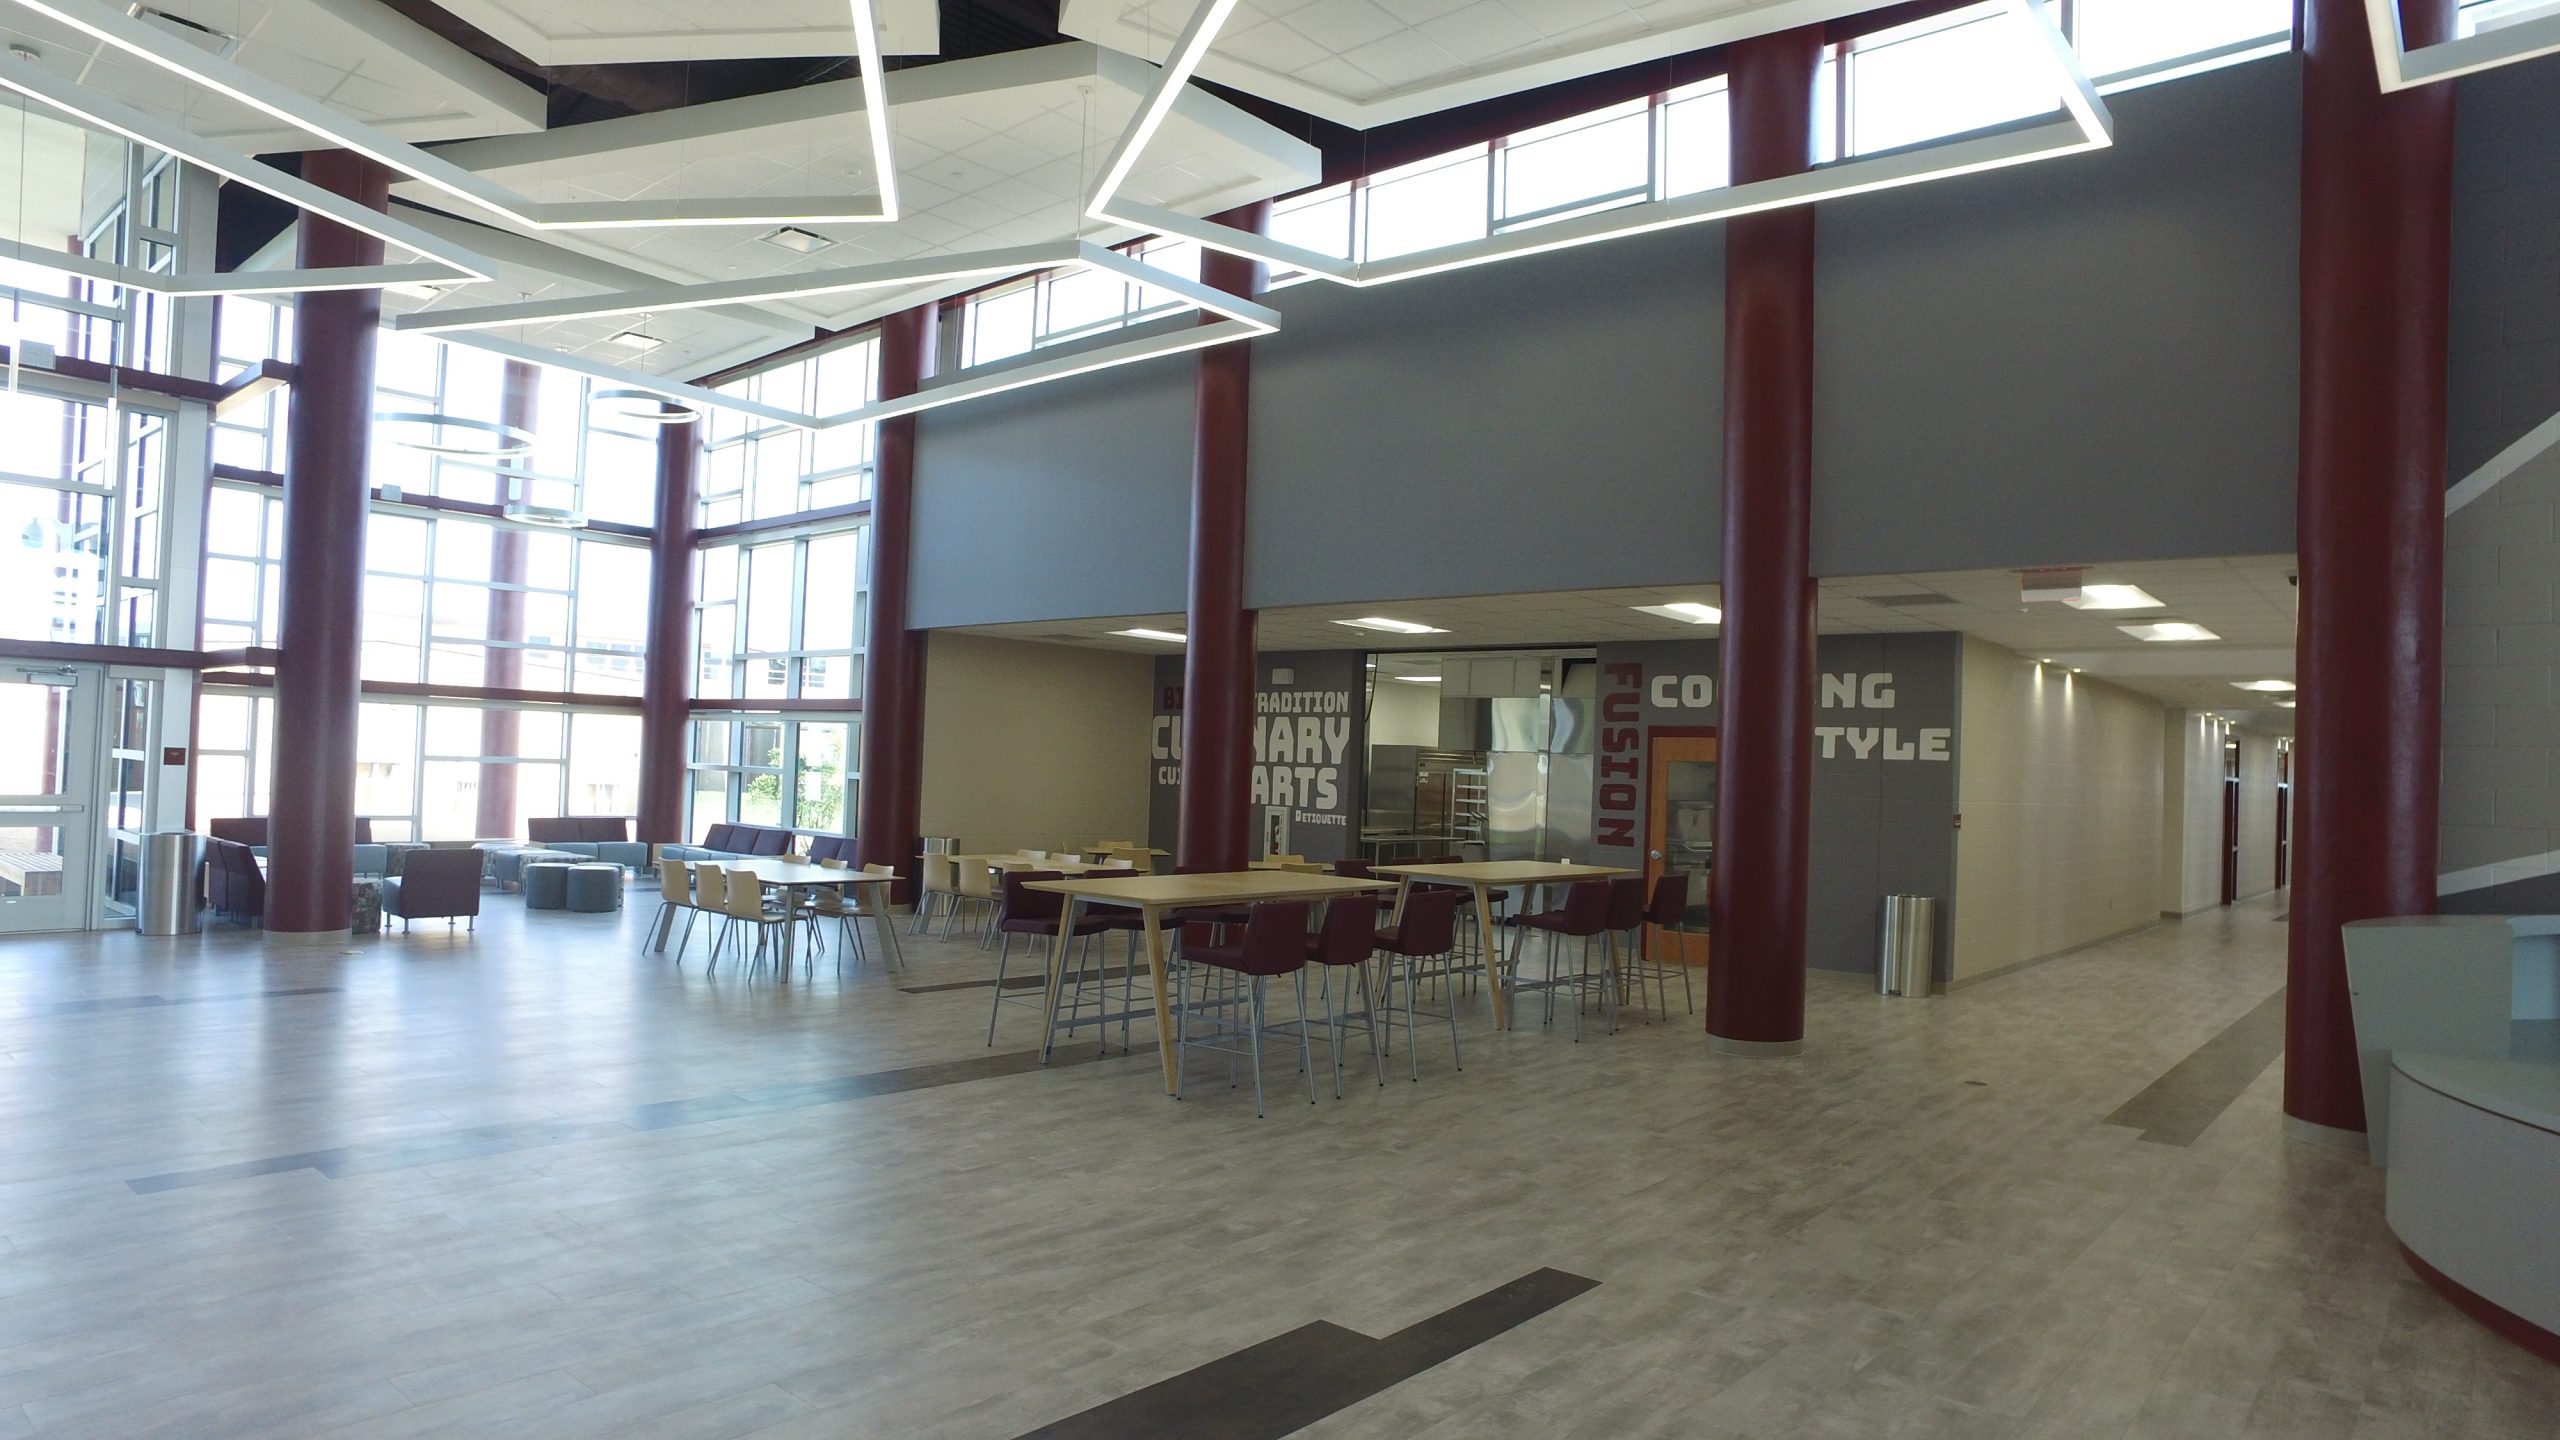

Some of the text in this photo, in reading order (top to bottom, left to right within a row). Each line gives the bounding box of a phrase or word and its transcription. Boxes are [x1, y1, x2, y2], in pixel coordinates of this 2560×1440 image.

[1254, 691, 1349, 713] RADITION
[1152, 715, 1350, 765] CUNARY
[1596, 663, 1642, 847] FUSION
[1814, 726, 1951, 761] TYLE
[1251, 765, 1338, 810] ARTS
[1302, 812, 1347, 826] ETIQUETTE
